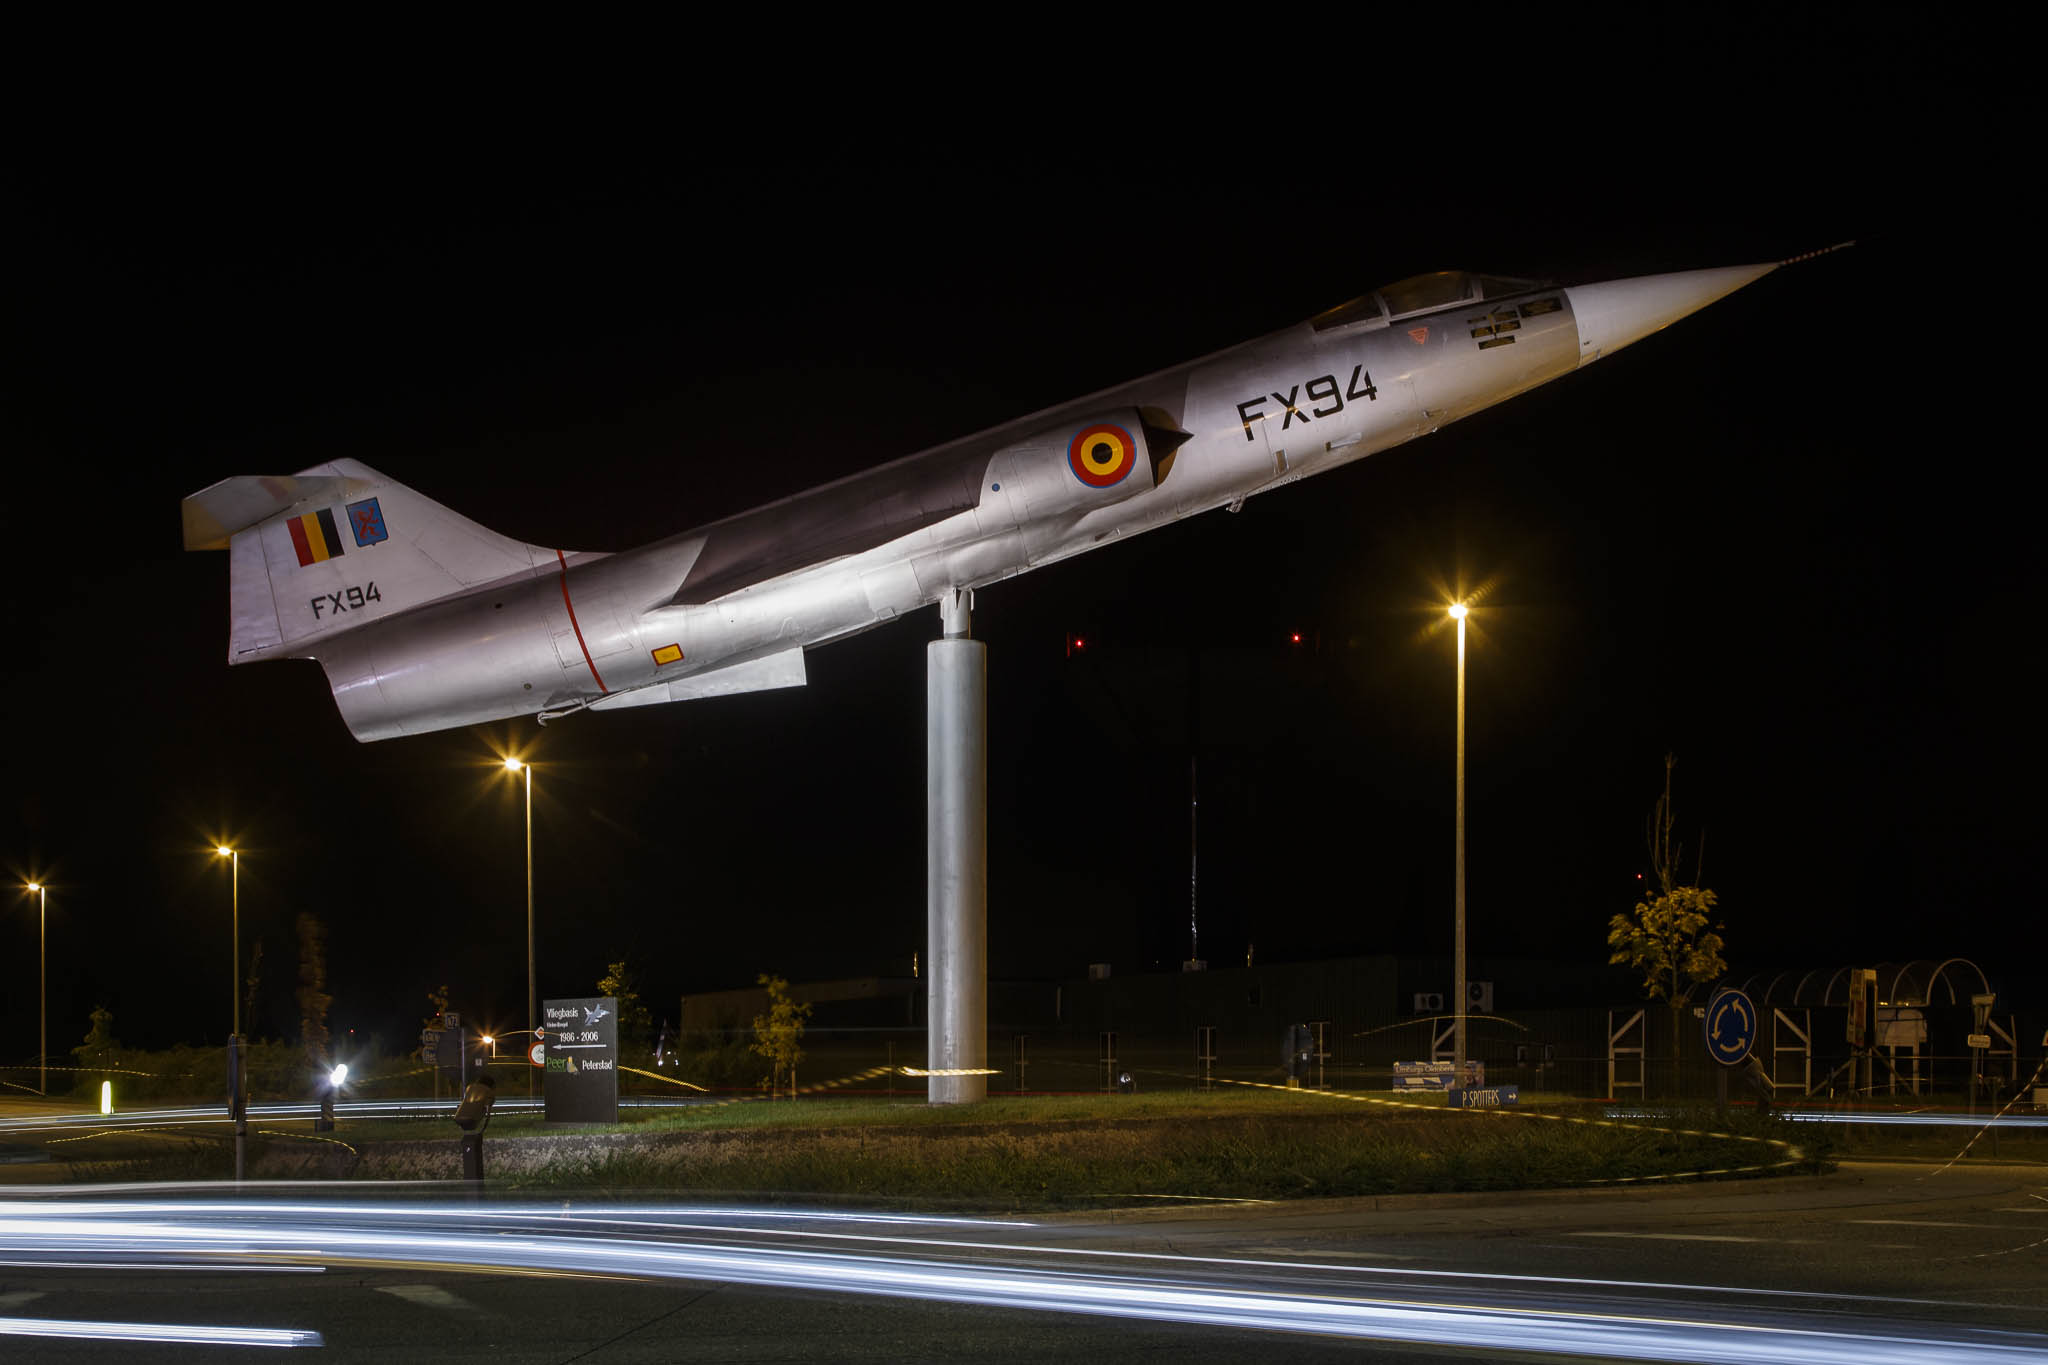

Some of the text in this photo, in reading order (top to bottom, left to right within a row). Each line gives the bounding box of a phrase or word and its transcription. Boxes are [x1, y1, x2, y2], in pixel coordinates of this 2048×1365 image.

[1236, 364, 1377, 441] FX94
[310, 582, 381, 619] FX94
[546, 1008, 578, 1019] Vliegbasis
[560, 1032, 575, 1042] 1986
[581, 1031, 598, 1042] 2006
[546, 1057, 613, 1071] Peer Peterstad
[1469, 1089, 1500, 1107] SPOTTERS
